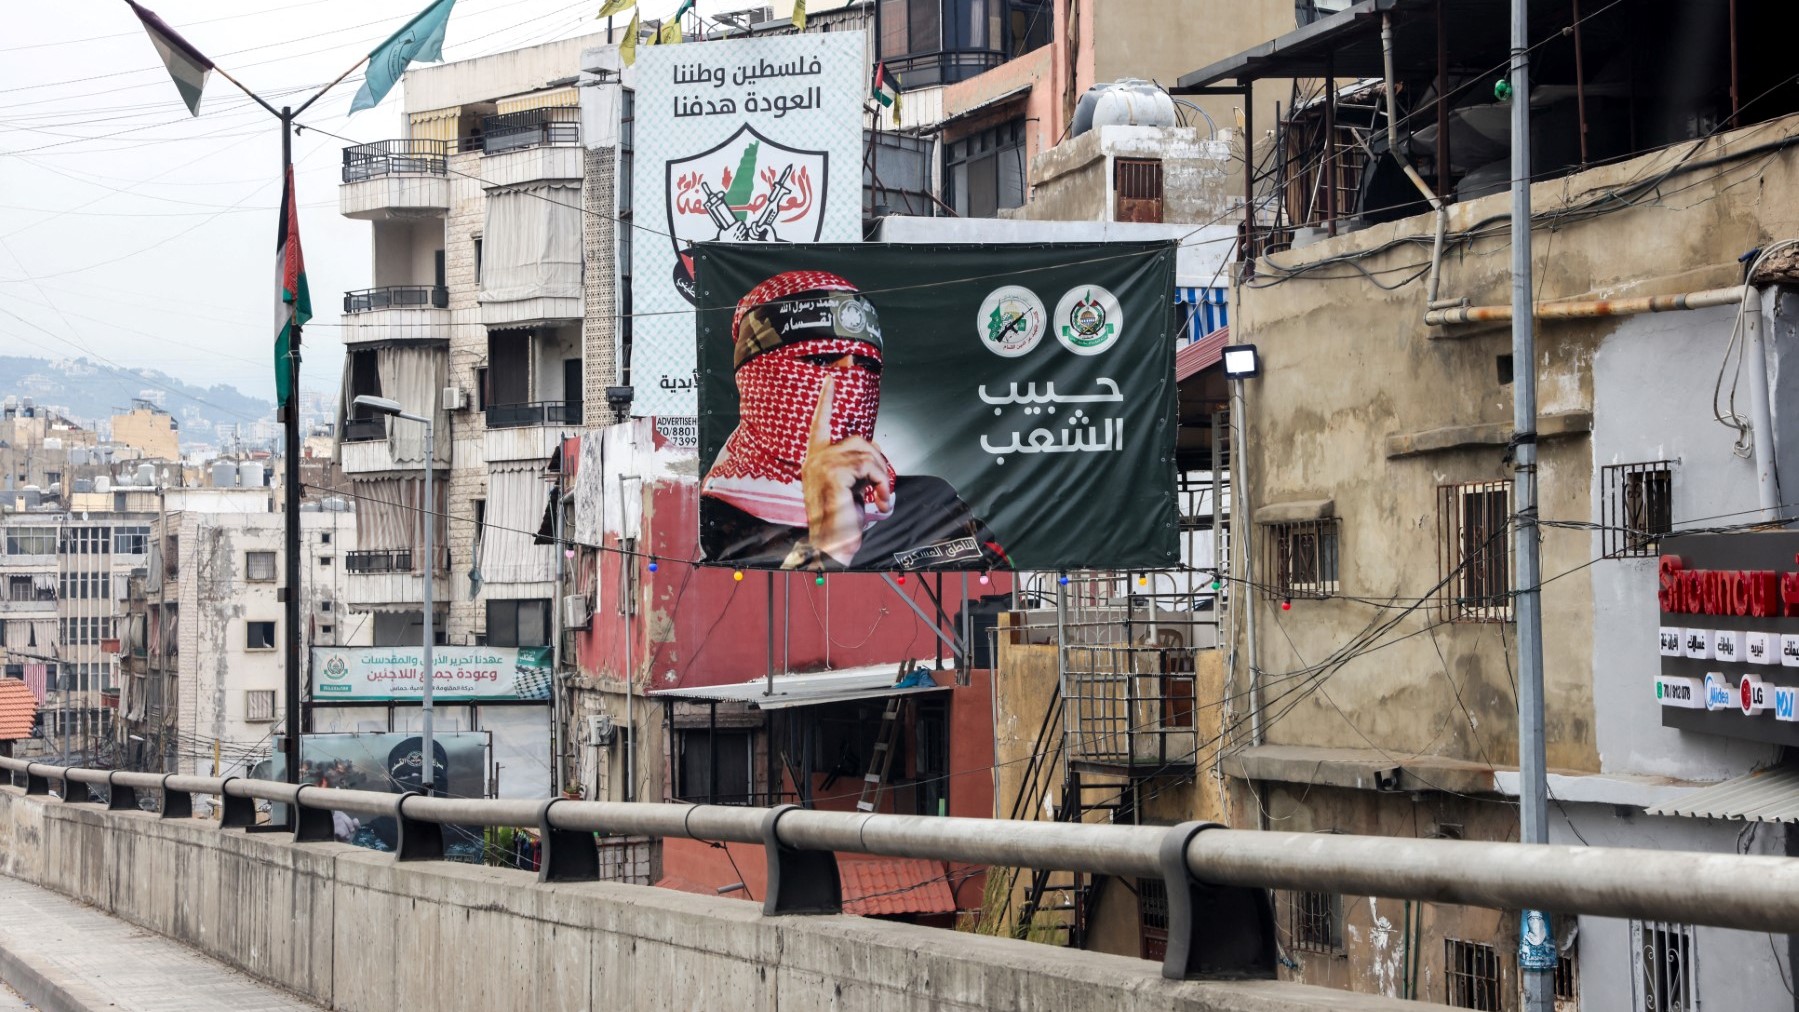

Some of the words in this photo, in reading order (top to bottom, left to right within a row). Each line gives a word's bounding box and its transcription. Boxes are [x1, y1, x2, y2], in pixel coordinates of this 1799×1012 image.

[673, 63, 726, 87] وطننا
[733, 55, 822, 86] فلسطين
[673, 95, 737, 118] هدفنا
[744, 86, 822, 118] العودة
[660, 368, 699, 393] أبدية
[978, 377, 1124, 416] حبيب
[657, 417, 697, 426] ADVERTISEH
[980, 409, 1124, 465] الشعب
[901, 546, 944, 568] العسكري
[945, 540, 976, 558] الناطق
[361, 655, 418, 667] والمقدسات
[449, 655, 473, 667] تحرير
[475, 655, 503, 665] عهدنا
[367, 667, 416, 682] اللاجئين
[419, 670, 453, 683] جمع
[456, 667, 498, 682] وعودة
[1752, 686, 1763, 704] LG
